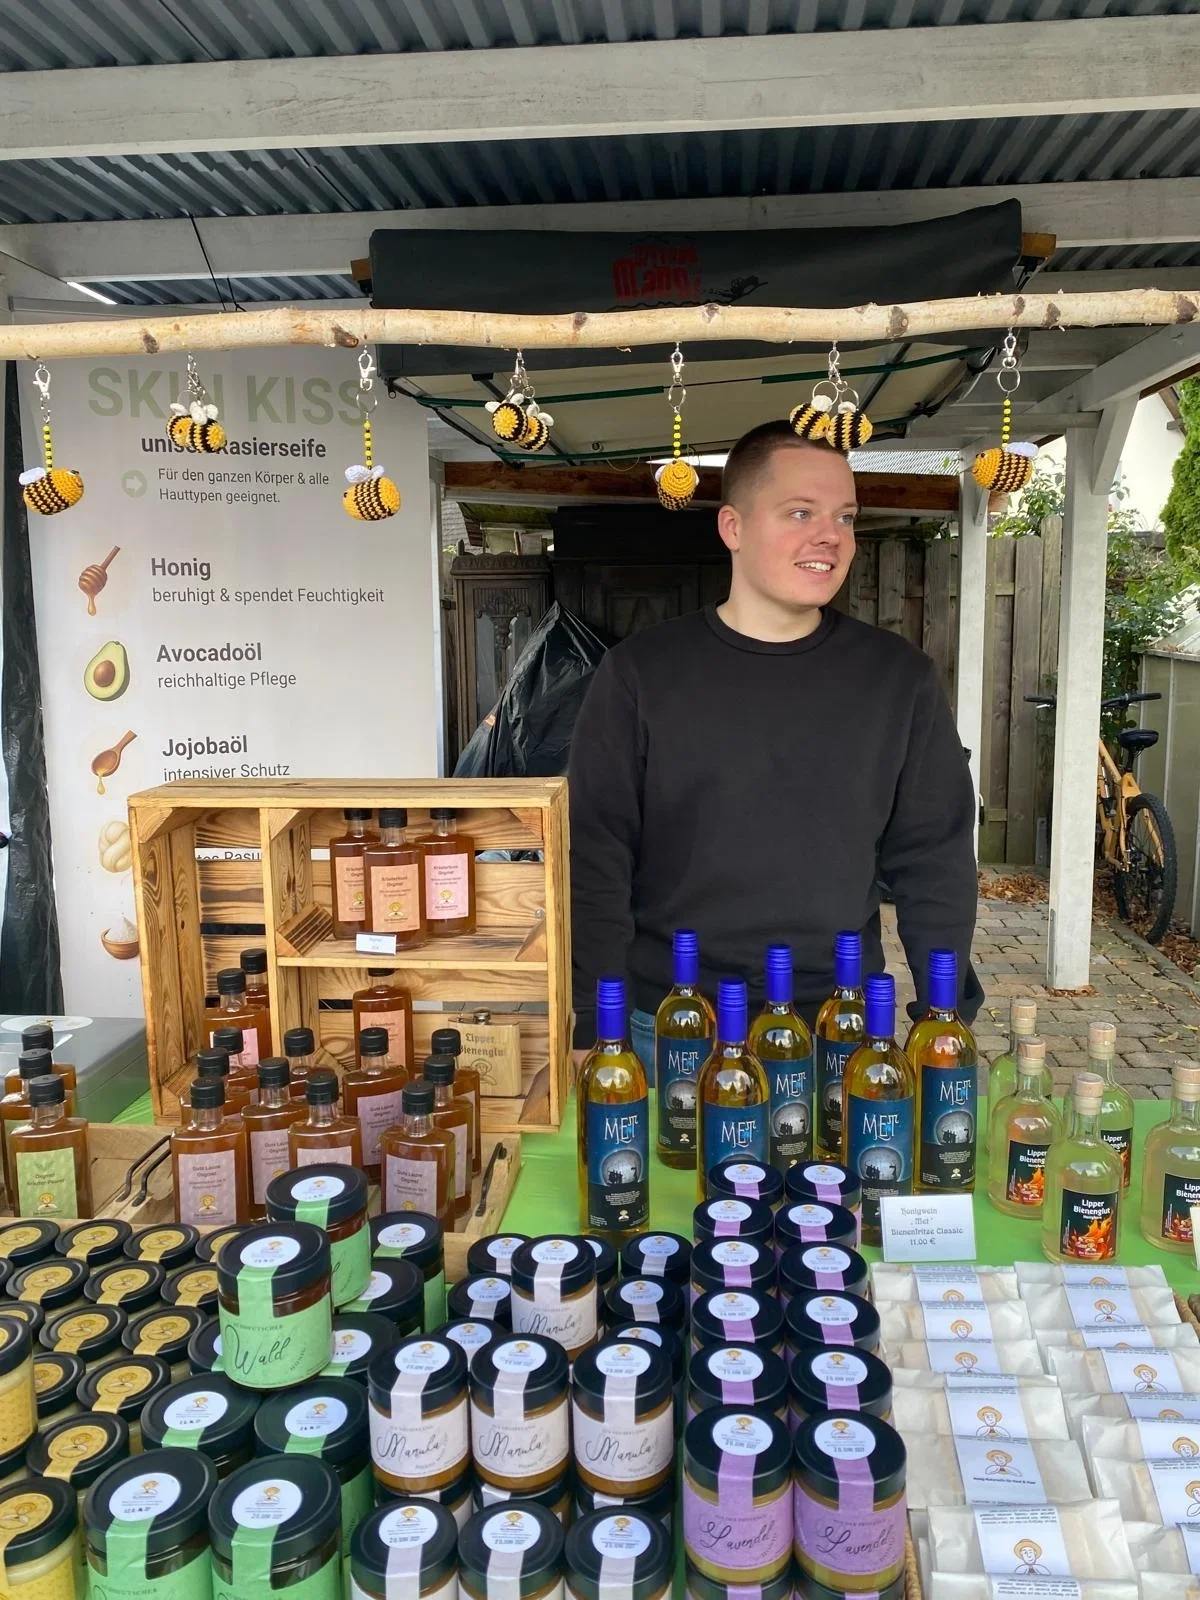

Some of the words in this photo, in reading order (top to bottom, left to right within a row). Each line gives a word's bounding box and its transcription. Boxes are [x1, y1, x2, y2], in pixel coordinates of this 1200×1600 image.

[247, 376, 369, 427] KISS
[213, 437, 326, 457] asierseife
[158, 468, 180, 482] Für
[183, 470, 205, 483] den
[209, 474, 251, 487] ganzen
[256, 472, 294, 488] Körper
[298, 475, 306, 485] &
[309, 474, 329, 485] alle
[159, 489, 222, 504] Hauttypen
[226, 492, 280, 505] geeignet.
[151, 558, 211, 580] Honig
[152, 588, 215, 606] beruhigt
[220, 588, 230, 602] &
[235, 588, 293, 606] spendet
[298, 588, 384, 606] Feuchtigkeit
[156, 642, 262, 663] Avocadoöl
[158, 673, 246, 689] reichhaltige
[250, 671, 297, 688] Pflege
[162, 735, 248, 760] Jojobaöl
[163, 765, 237, 782] intensiver
[240, 763, 290, 779] Schutz
[668, 1050, 700, 1076] MET
[826, 1052, 850, 1077] ME
[775, 1071, 807, 1098] MET
[939, 1079, 973, 1106] MET
[604, 1114, 639, 1145] MET
[720, 1119, 757, 1149] MET
[862, 1112, 900, 1141] MET
[1103, 1134, 1123, 1143] Lipper
[1019, 1155, 1046, 1165] Bieneng
[1027, 1149, 1048, 1158] Lipper
[1176, 1189, 1200, 1199] Bienen
[1184, 1183, 1200, 1193] Lipp
[1073, 1205, 1111, 1217] Bienenglut
[1081, 1199, 1105, 1209] Lipper
[936, 1227, 964, 1235] Classic
[224, 1324, 291, 1376] Wald
[700, 1520, 776, 1551] Lavendel
[816, 1523, 894, 1556] Lavendel
